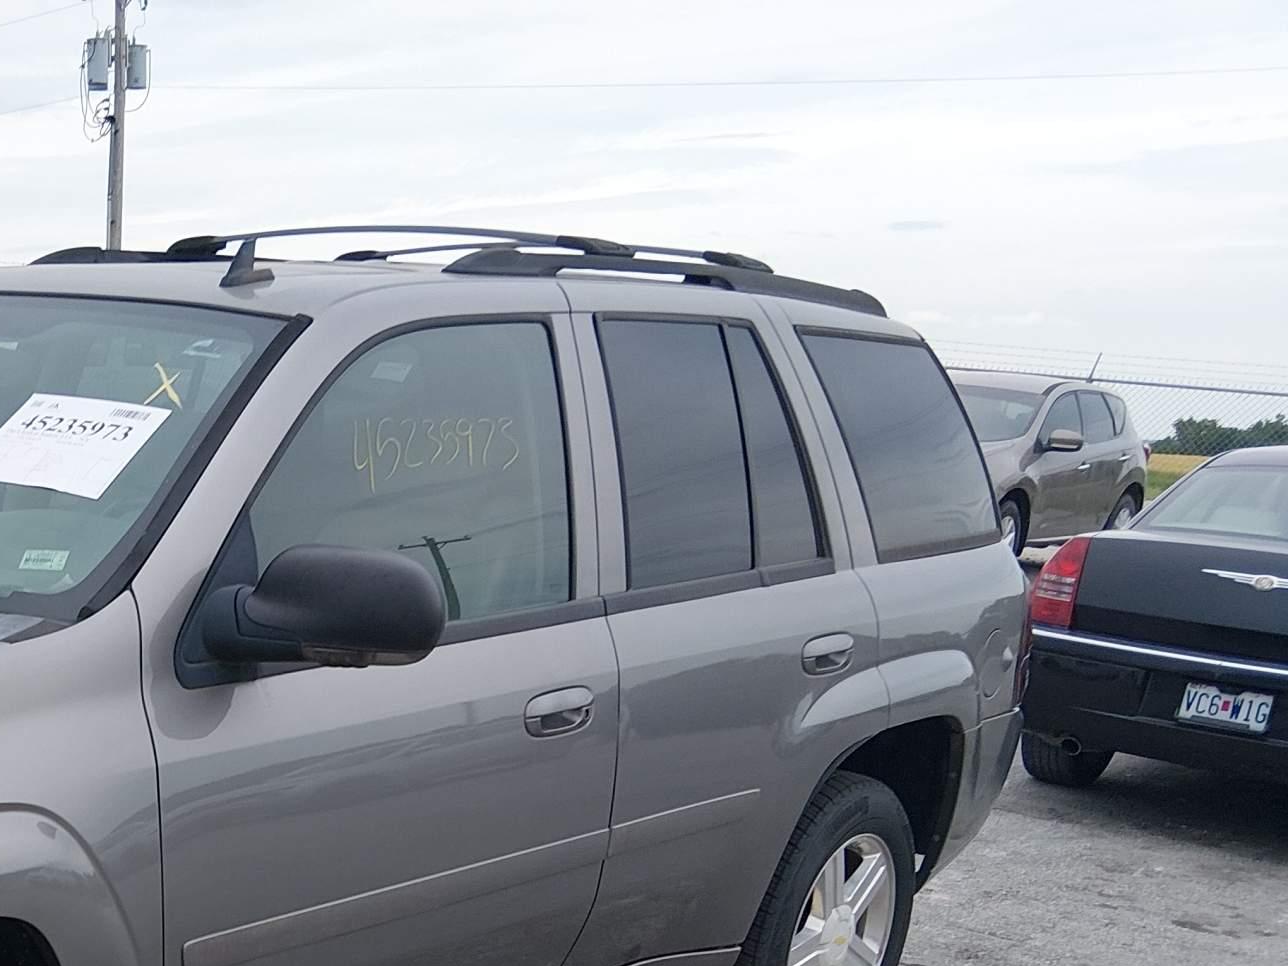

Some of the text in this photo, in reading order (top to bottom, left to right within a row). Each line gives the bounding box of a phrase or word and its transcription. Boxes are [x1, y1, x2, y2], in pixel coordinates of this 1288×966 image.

[21, 414, 133, 440] 45235973
[353, 417, 520, 494] 45235973
[1186, 690, 1269, 724] VC6 W1G
